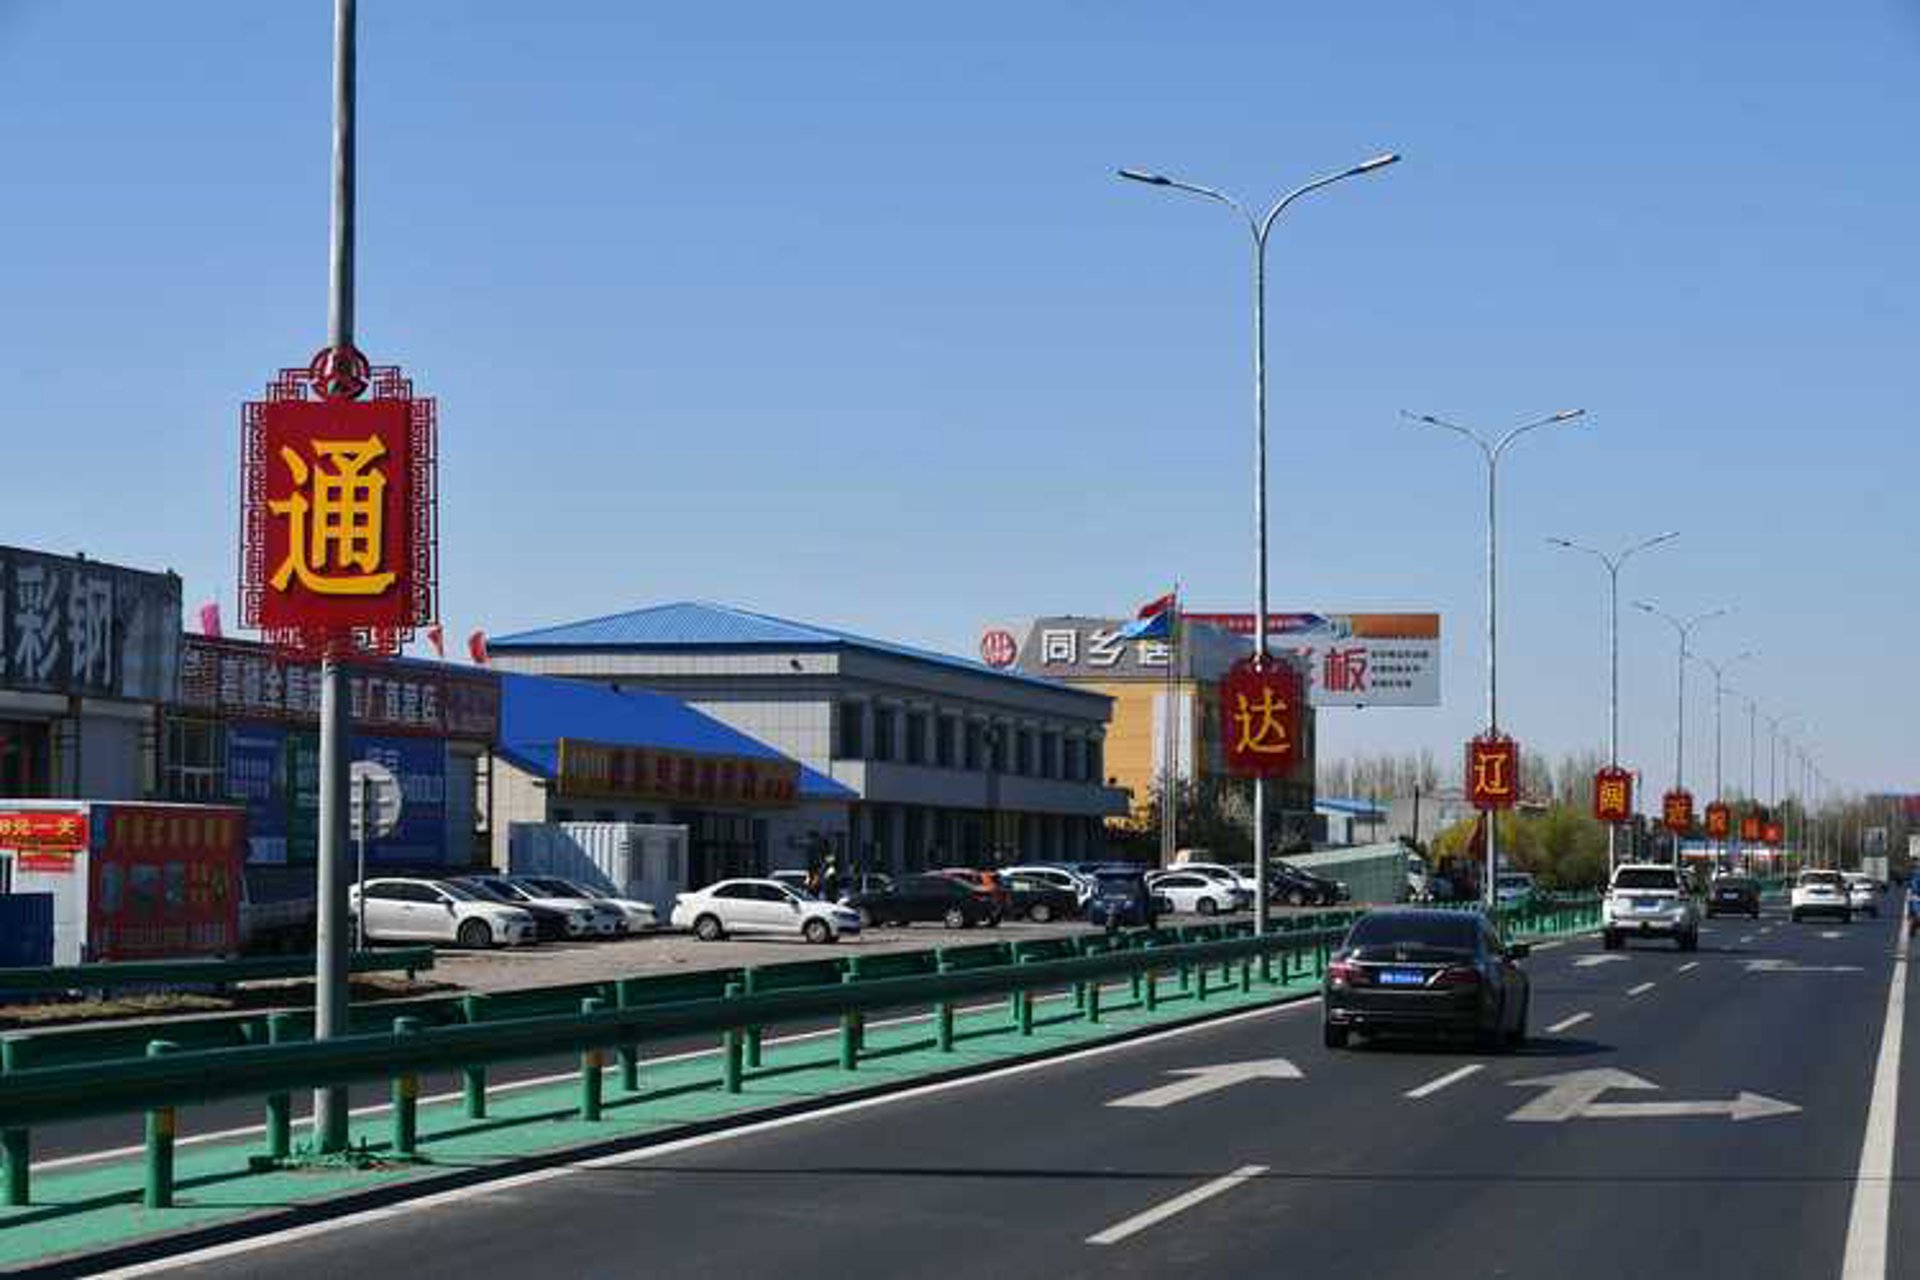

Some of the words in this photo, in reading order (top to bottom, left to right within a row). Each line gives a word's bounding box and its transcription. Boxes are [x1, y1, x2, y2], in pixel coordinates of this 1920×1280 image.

[266, 433, 397, 596] 通
[1234, 687, 1292, 754] 达
[1474, 751, 1510, 795] 辽
